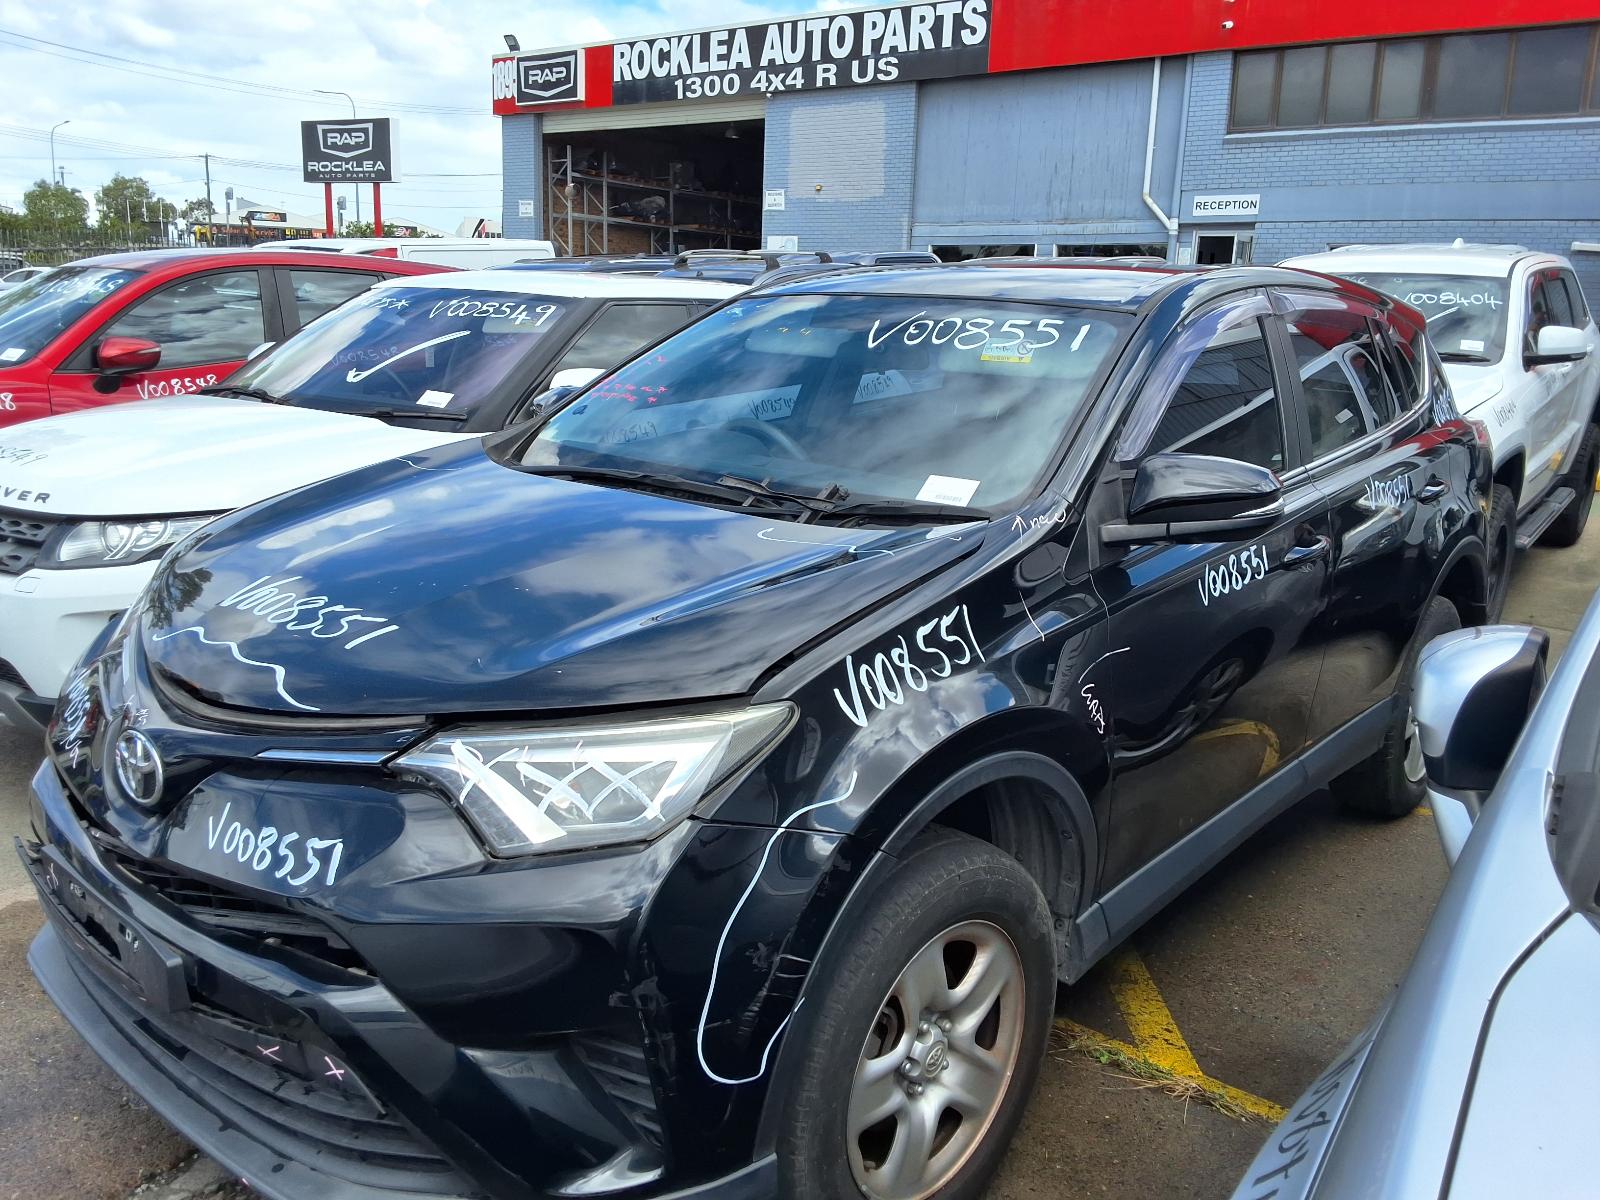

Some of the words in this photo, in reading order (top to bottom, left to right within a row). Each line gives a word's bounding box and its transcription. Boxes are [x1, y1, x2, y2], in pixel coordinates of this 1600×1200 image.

[613, 28, 752, 82] ROCKLEA
[760, 15, 855, 66] AUTO
[862, 0, 988, 57] PARTS
[528, 67, 566, 84] RAP
[674, 73, 741, 99] 1300
[750, 66, 804, 92] 4x4
[816, 63, 837, 87] R
[851, 57, 899, 83] US
[327, 132, 365, 146] RAP
[307, 161, 386, 172] ROCKLEA
[1195, 200, 1258, 211] RECEPTION
[429, 296, 556, 327] V008549
[867, 310, 1091, 352] V008551
[0, 485, 51, 503] VER
[1198, 544, 1269, 607] V008551
[219, 575, 400, 650] V008551
[833, 604, 986, 728] V008551
[208, 802, 344, 886] V008551
